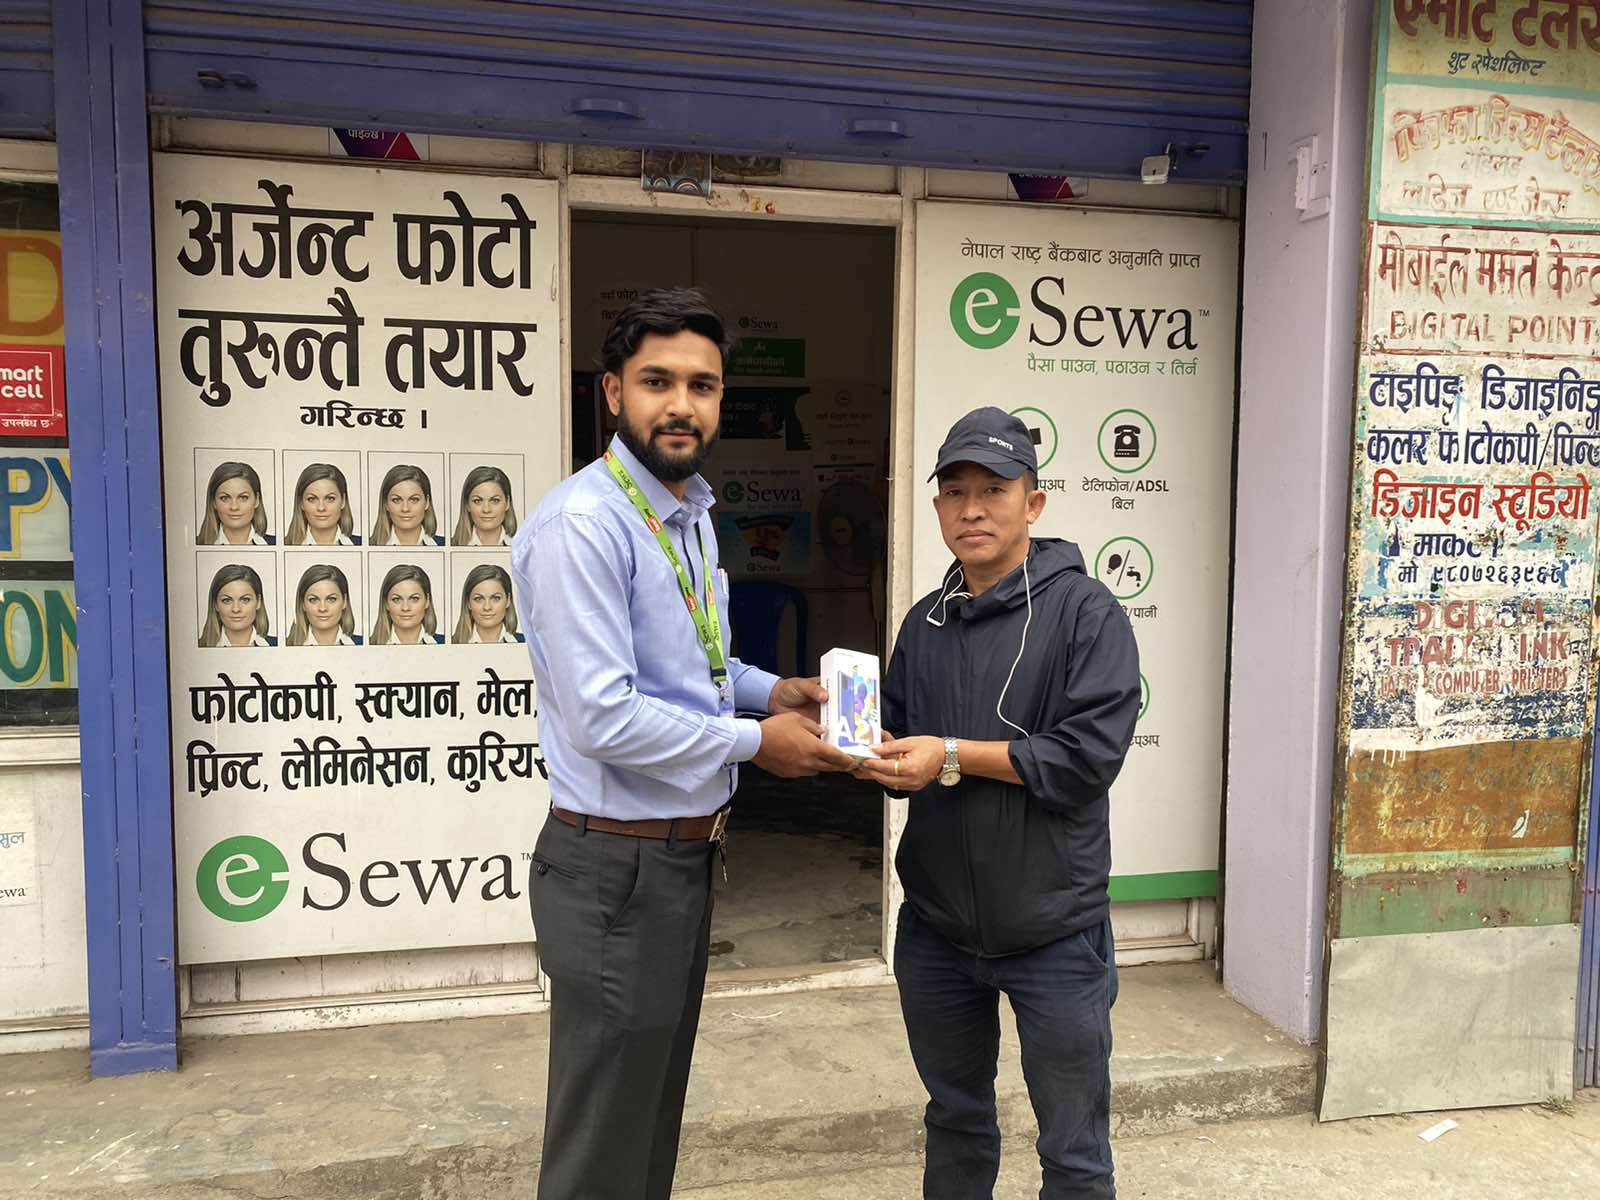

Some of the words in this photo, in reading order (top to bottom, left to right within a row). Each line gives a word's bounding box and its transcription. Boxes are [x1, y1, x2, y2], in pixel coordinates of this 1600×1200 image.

[175, 180, 374, 283] अर्जेन्ट
[393, 191, 537, 290] फोटो
[961, 238, 1005, 260] नेपाल
[1011, 245, 1043, 265] राष्ट्र
[1048, 241, 1103, 264] बैंकबाट
[1108, 249, 1164, 270] अनुमति
[1169, 253, 1201, 269] प्राप्त
[384, 317, 538, 397] तयार
[1028, 352, 1055, 373] पैसा
[1061, 358, 1098, 375] पाउन,
[1105, 360, 1151, 375] पठाउन
[1156, 361, 1167, 376] र
[1171, 357, 1199, 376] तिर्न
[1, 383, 44, 399] cell
[300, 400, 406, 430] गरिन्छ
[988, 436, 1014, 451] SPORTS
[1367, 428, 1431, 465] कलर
[1112, 496, 1135, 510] बिल
[1371, 468, 1484, 525] डिजाइन
[189, 671, 343, 724] फोटोकपी,
[355, 681, 465, 724] स्क्यान,
